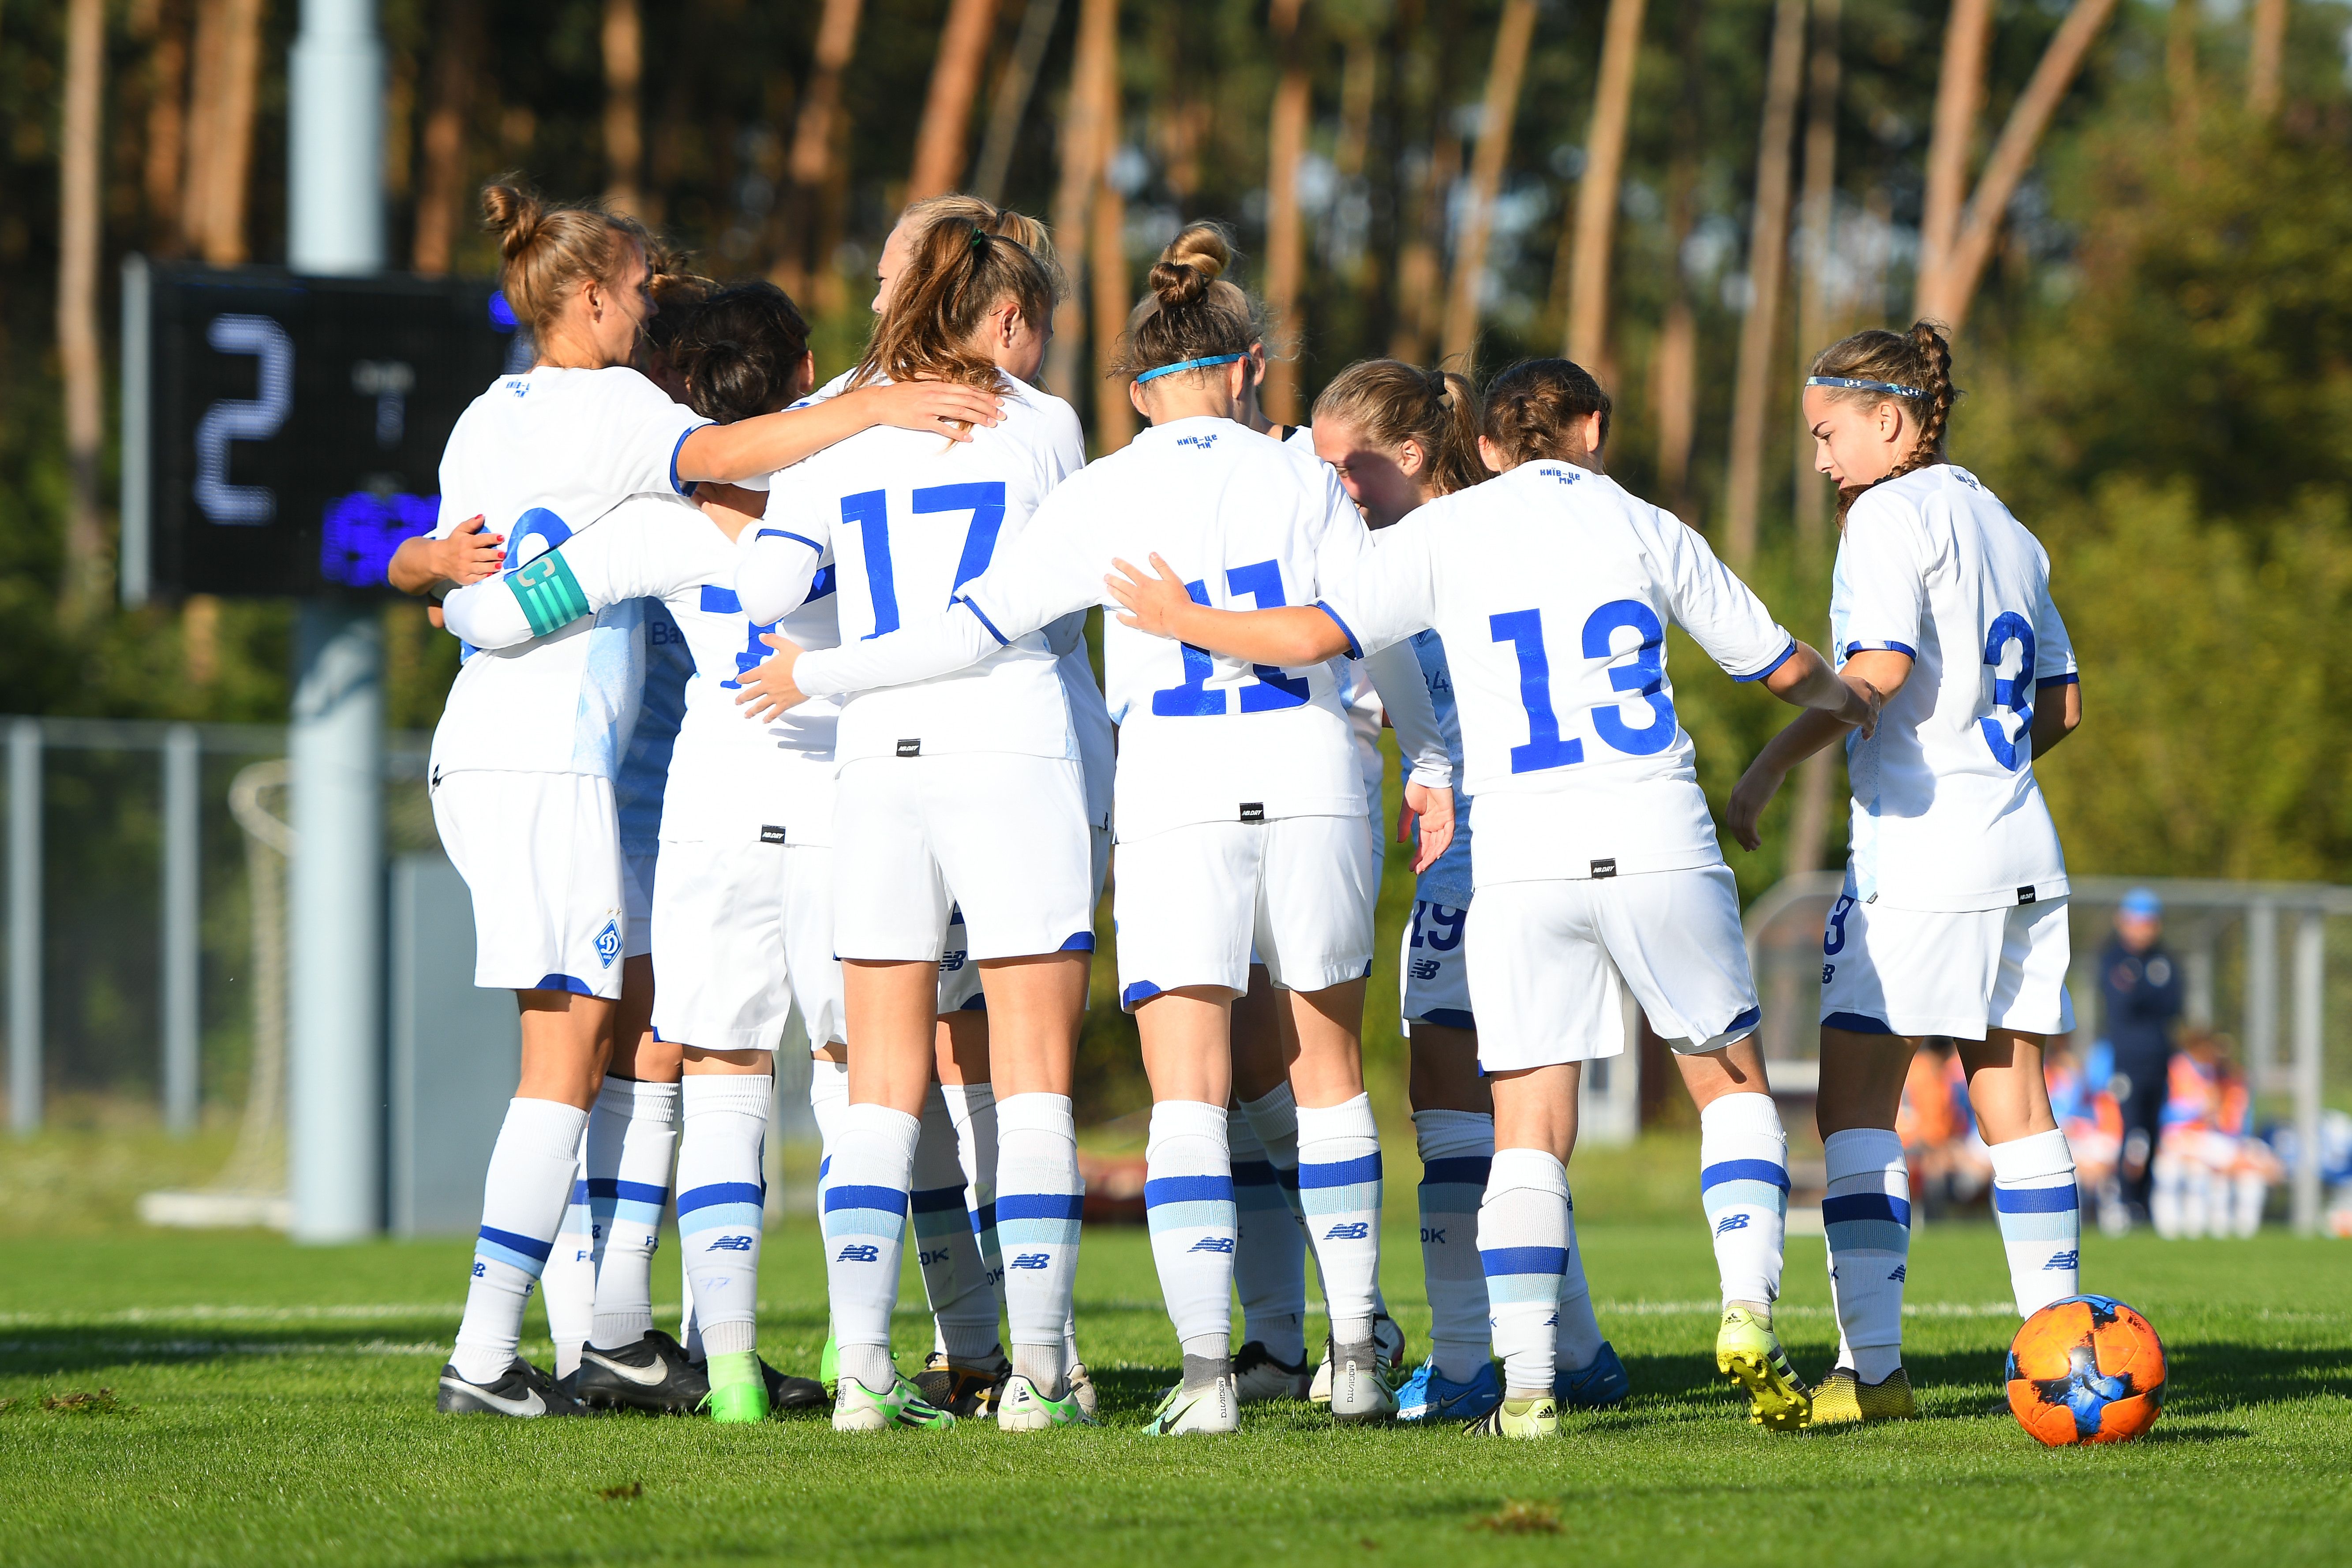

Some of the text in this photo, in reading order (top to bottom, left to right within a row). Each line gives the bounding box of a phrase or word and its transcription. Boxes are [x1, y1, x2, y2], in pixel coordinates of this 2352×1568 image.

[193, 313, 295, 526] 2
[841, 482, 1005, 641] 17
[652, 621, 684, 645] Ba
[1152, 559, 1310, 716] 11
[1489, 599, 1679, 774] 13
[1978, 611, 2036, 772] 3
[1410, 900, 1467, 951] 19
[1824, 894, 1855, 955] 3
[1410, 958, 1441, 980] NB
[1822, 963, 1835, 984] B
[1323, 1222, 1368, 1240] NB
[1420, 1228, 1446, 1243] DK
[1715, 1214, 1750, 1239] NB
[706, 1236, 753, 1251] NB
[836, 1245, 879, 1262] NB
[1187, 1237, 1234, 1253] NB
[1010, 1254, 1050, 1269] NB
[2042, 1250, 2079, 1270] NB
